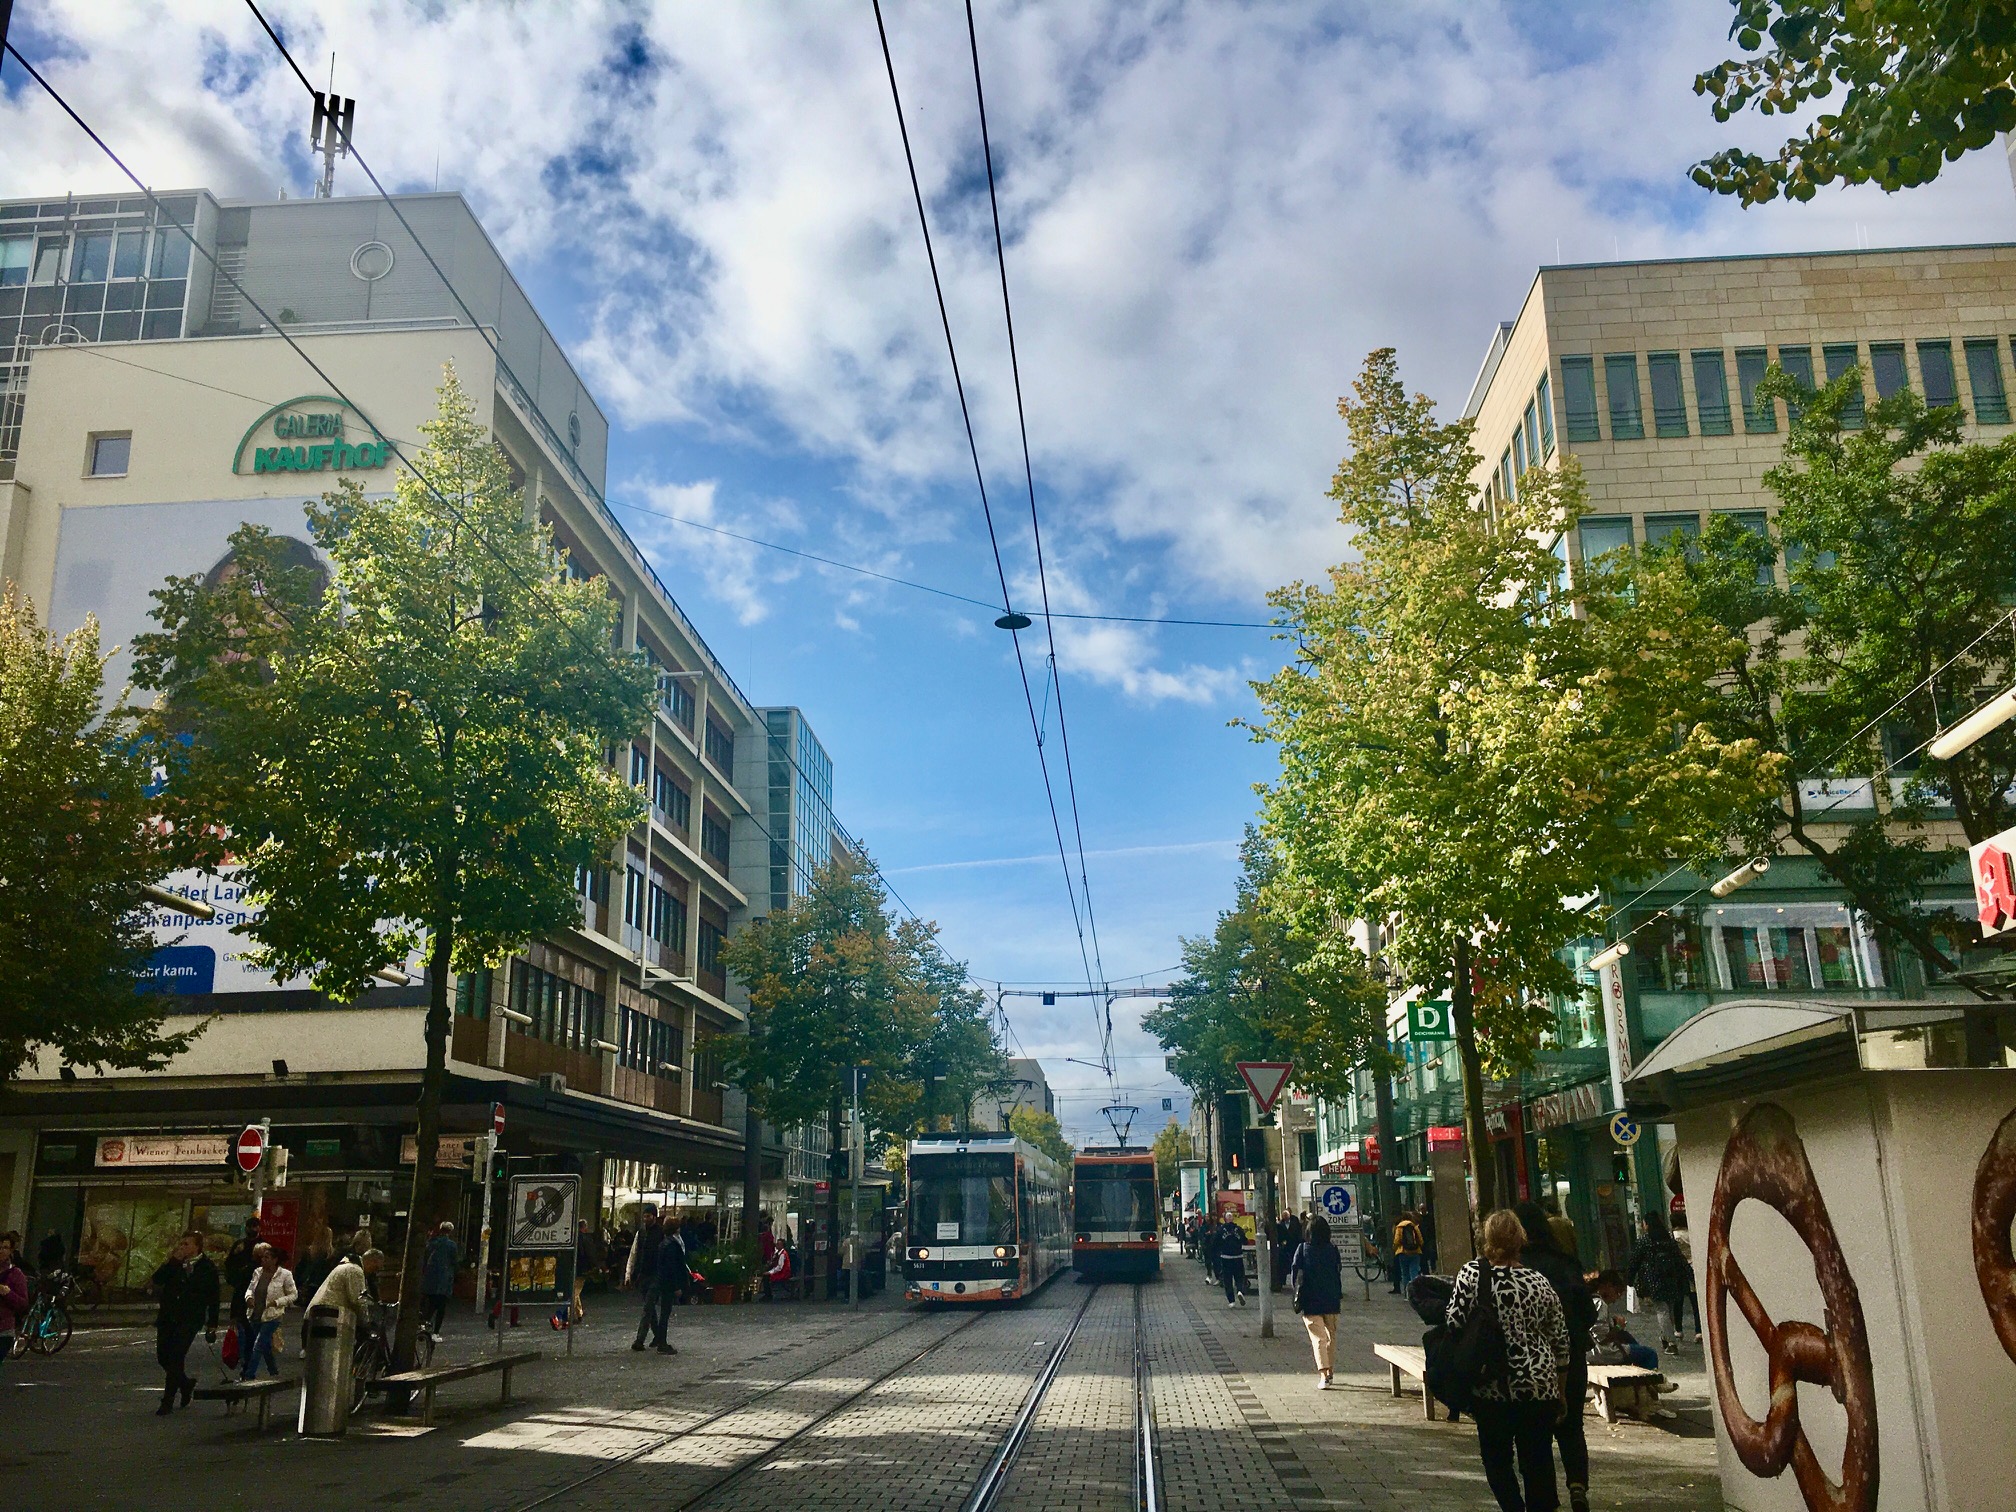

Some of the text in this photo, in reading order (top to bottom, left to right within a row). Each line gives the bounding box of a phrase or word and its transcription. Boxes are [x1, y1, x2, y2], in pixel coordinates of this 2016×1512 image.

[274, 413, 343, 439] GALERIA
[162, 965, 198, 977] kann.
[1417, 1006, 1440, 1029] D
[135, 1146, 170, 1156] Wiener
[1328, 1165, 1353, 1173] HEMA
[1328, 1216, 1349, 1224] ZONE
